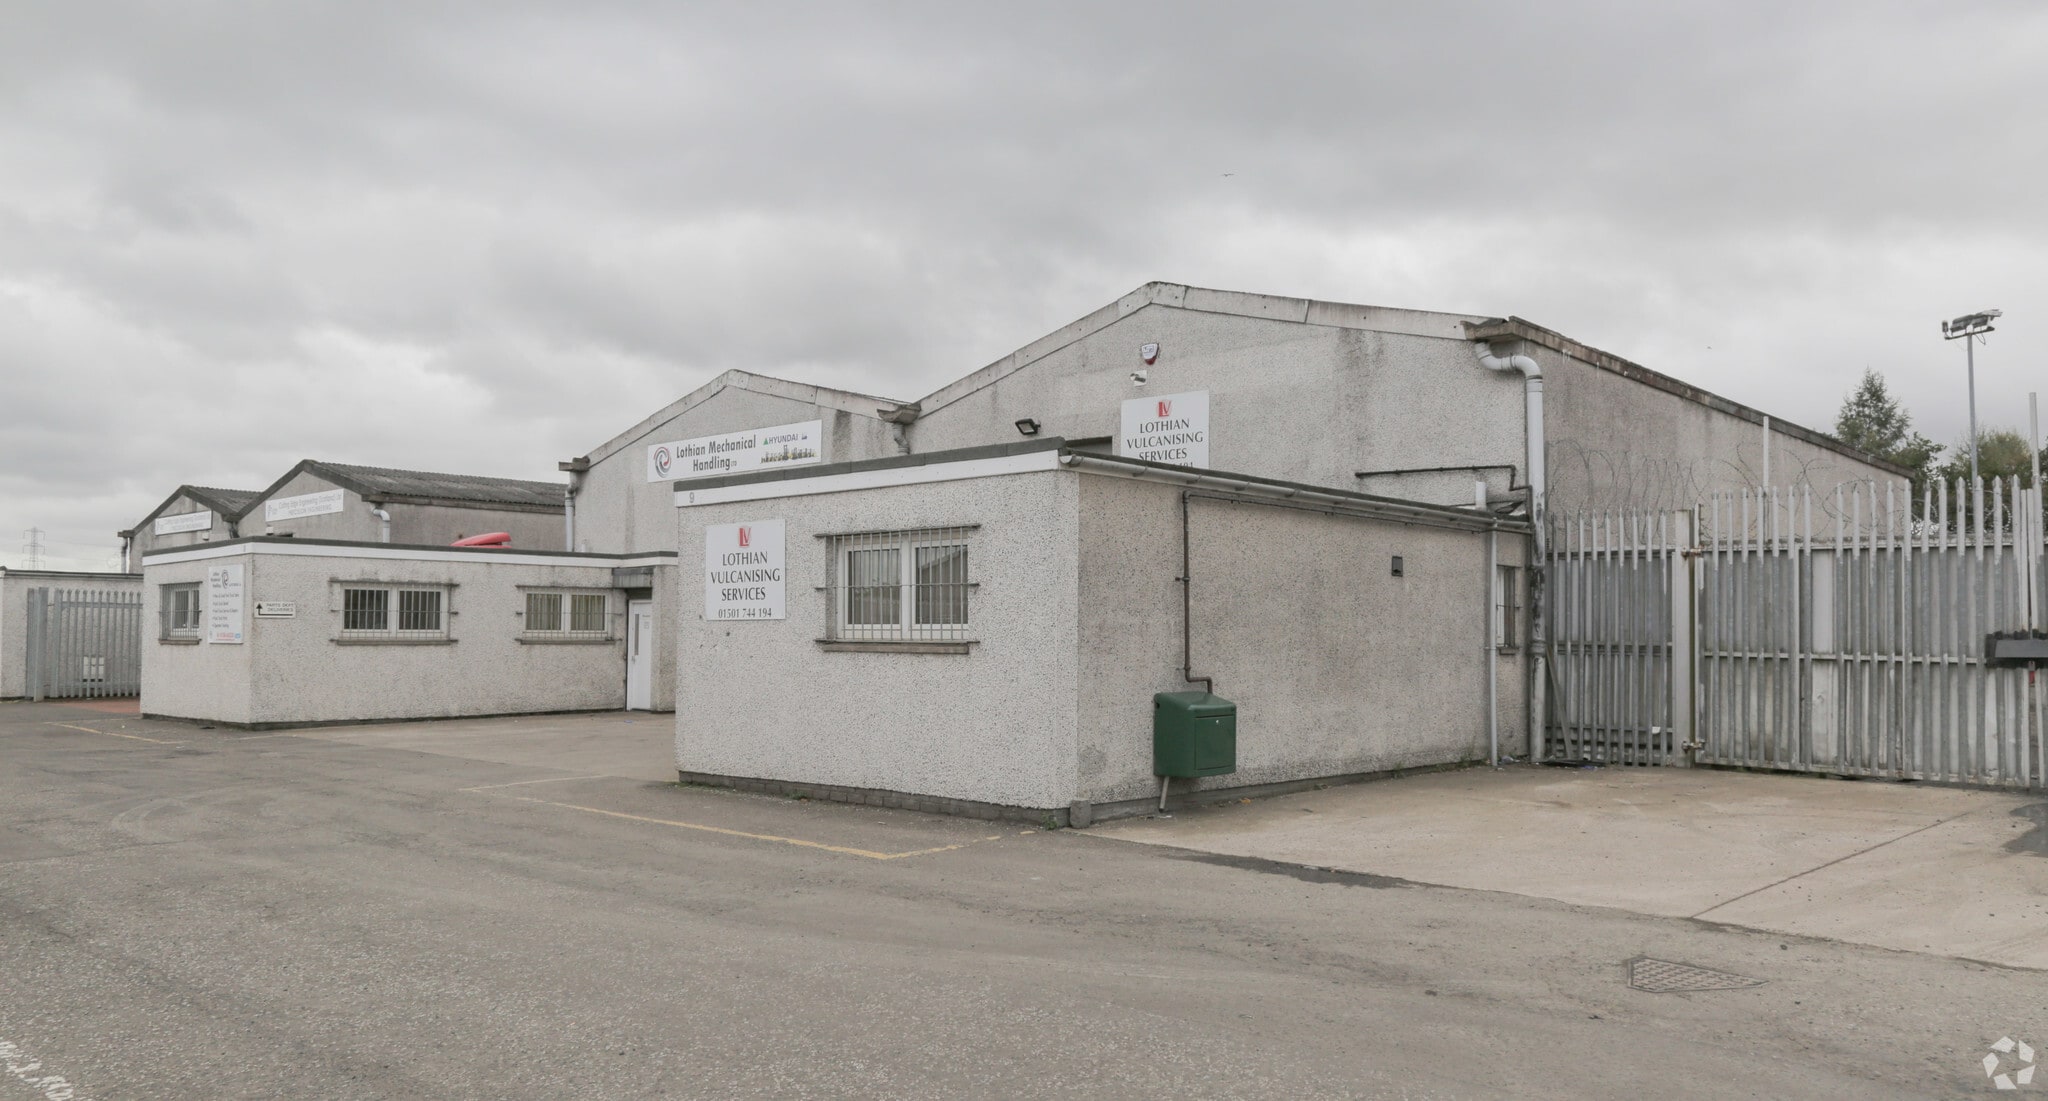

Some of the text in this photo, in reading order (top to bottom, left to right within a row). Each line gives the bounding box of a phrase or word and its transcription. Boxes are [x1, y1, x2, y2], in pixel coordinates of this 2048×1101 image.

[1140, 418, 1190, 434] LOTHIAN
[676, 434, 756, 459] Lothian Mechanical
[768, 433, 799, 445] HYUNDAI
[1127, 431, 1204, 449] VULCANISING
[1139, 447, 1187, 461] SERVICES
[693, 456, 731, 471] Handling
[689, 491, 695, 503] 9
[722, 551, 768, 566] LOTHIAN
[710, 568, 780, 584] VULCANISING
[721, 587, 766, 601] SERVICES
[718, 607, 772, 618] 01501 744 194
